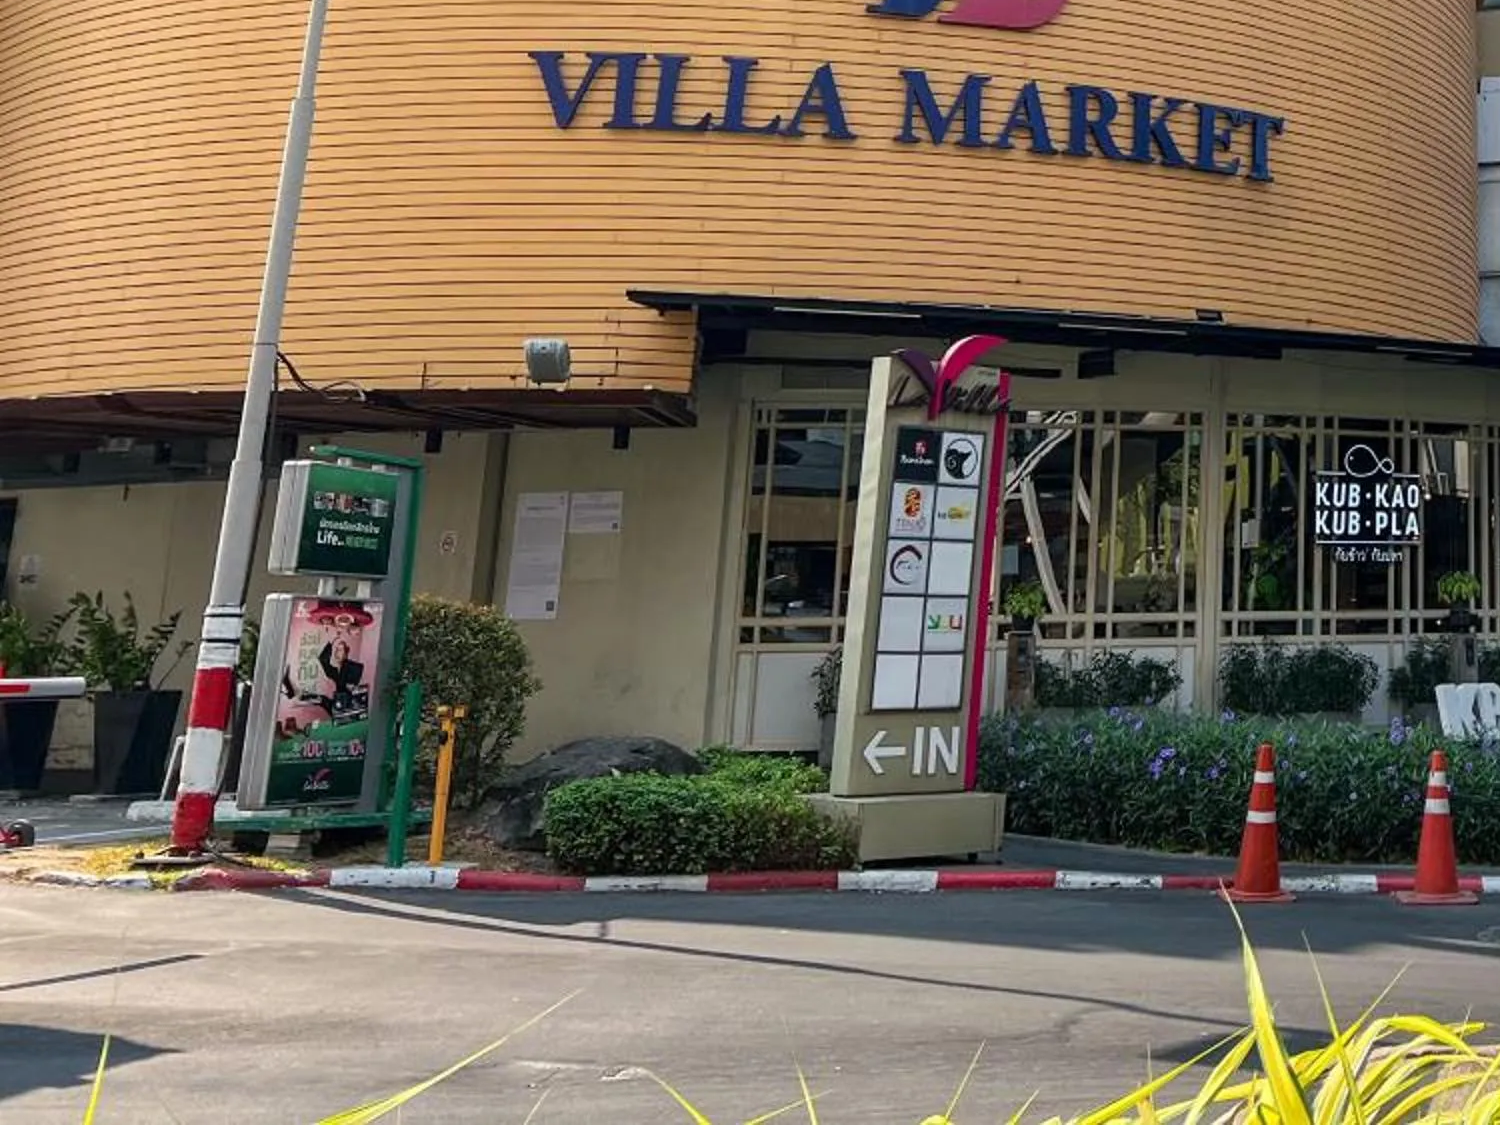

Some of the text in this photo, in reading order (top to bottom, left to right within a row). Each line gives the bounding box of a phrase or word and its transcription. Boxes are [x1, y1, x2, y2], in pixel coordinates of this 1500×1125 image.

[528, 51, 1284, 183] VILLA MARKET
[1315, 482, 1420, 508] KUB KAO
[1315, 510, 1420, 536] KUB PLA
[912, 726, 960, 775] IN
